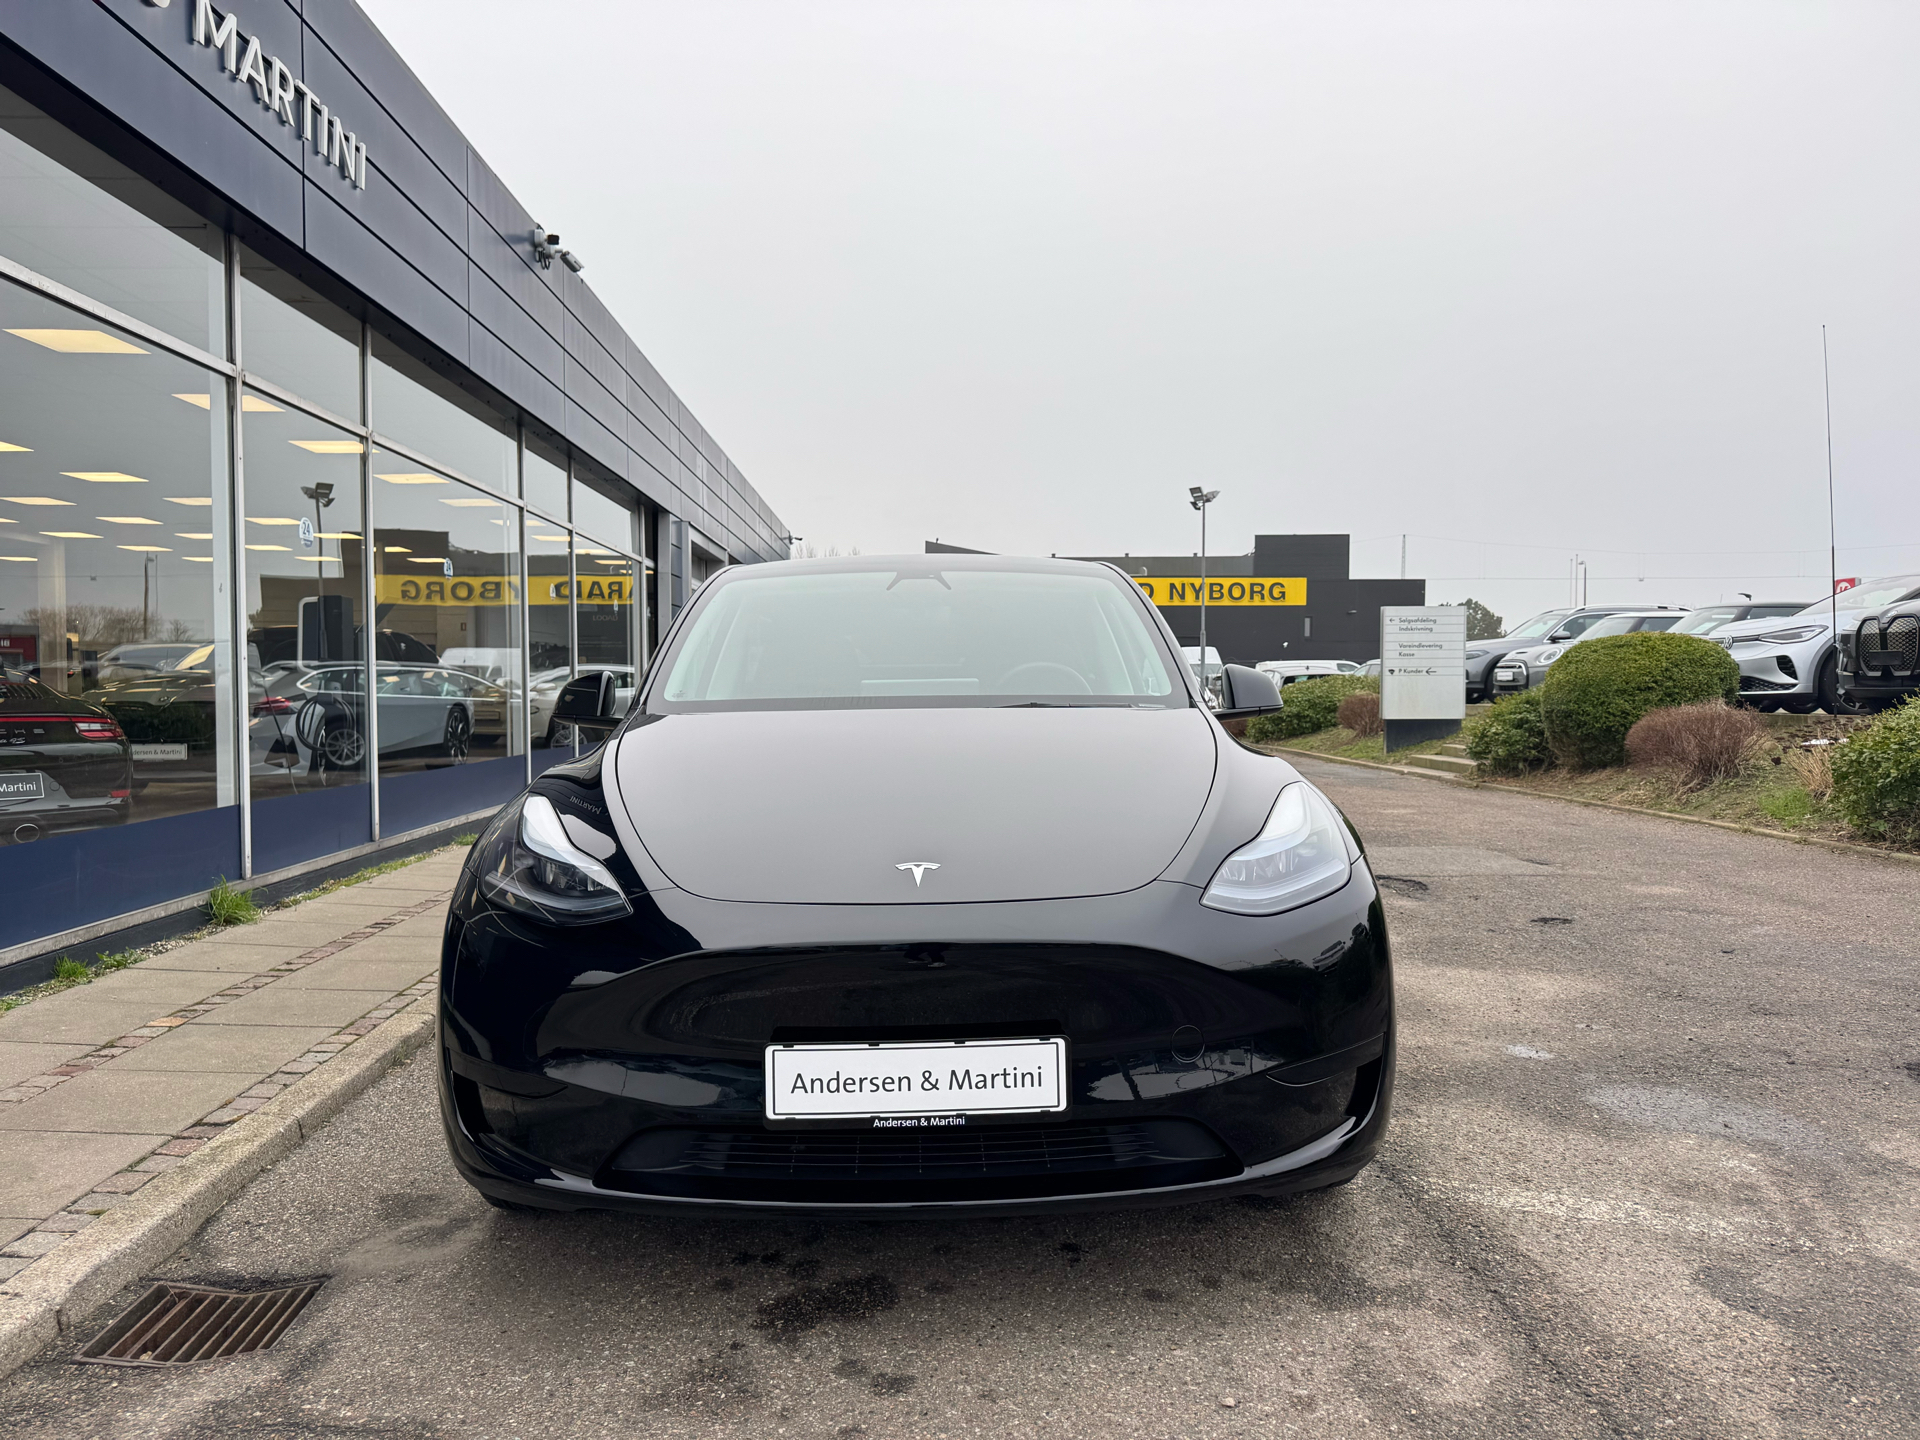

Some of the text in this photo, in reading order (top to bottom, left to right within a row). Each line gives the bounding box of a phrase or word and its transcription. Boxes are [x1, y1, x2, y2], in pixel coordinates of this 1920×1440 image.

[193, 0, 367, 191] MARTINI
[1169, 582, 1286, 601] NYBORG
[1398, 642, 1443, 650] Vareindlevering
[0, 782, 37, 792] Martini
[790, 1065, 1043, 1095] Andersen & Martini
[873, 1116, 965, 1128] Andersen & Martini
